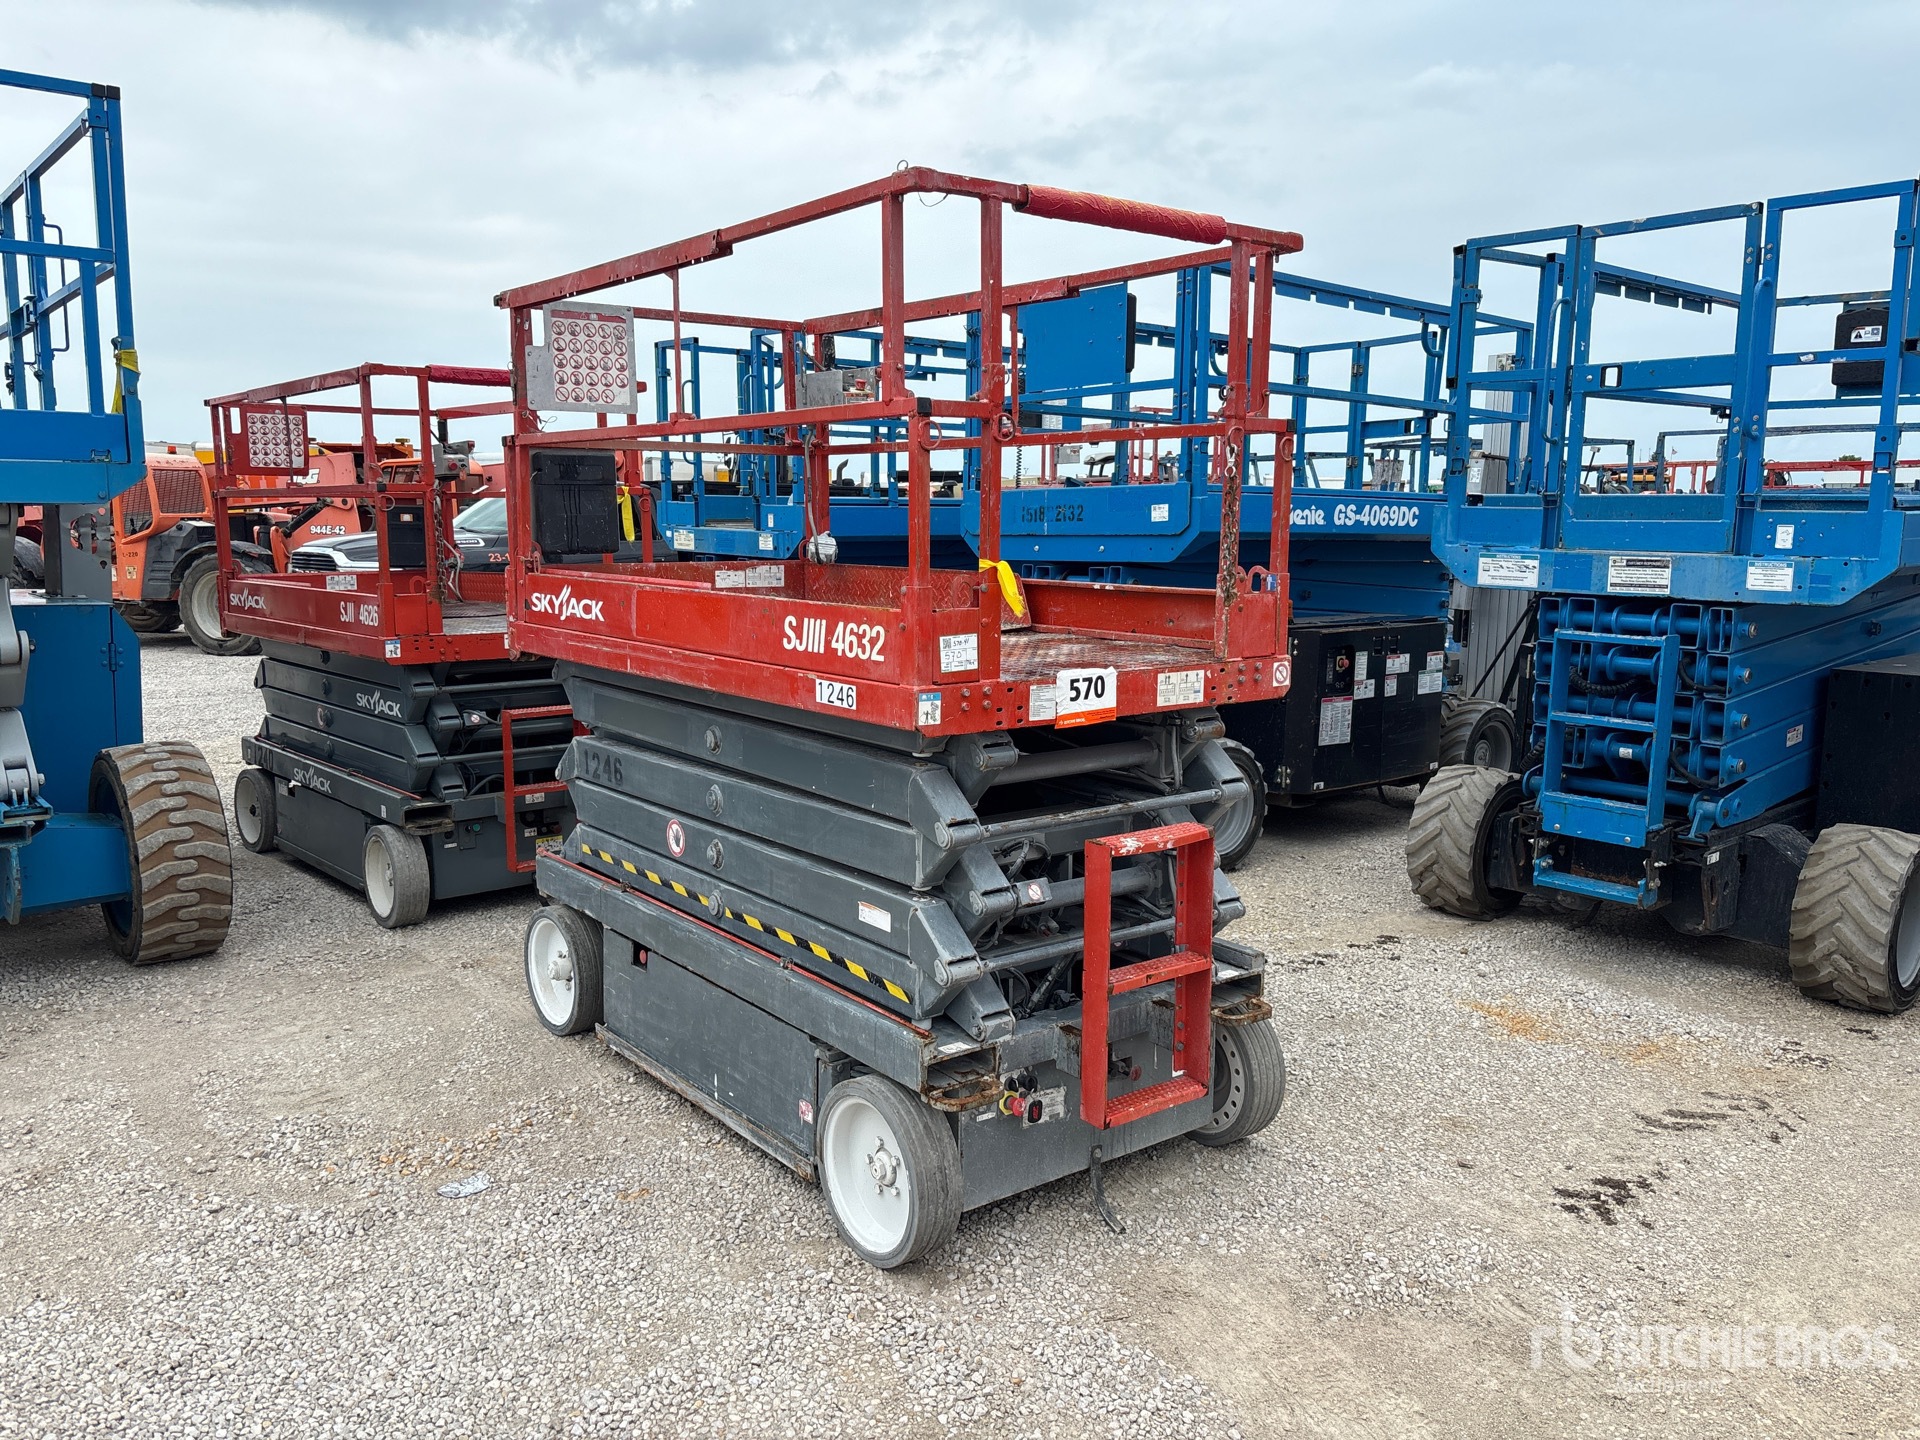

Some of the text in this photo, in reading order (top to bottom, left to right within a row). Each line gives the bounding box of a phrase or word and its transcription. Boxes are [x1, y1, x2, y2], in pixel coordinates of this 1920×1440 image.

[1290, 504, 1419, 527] enie GS-4069DC
[310, 526, 346, 535] 944E-42
[229, 587, 267, 611] SKYJACK
[529, 583, 605, 622] SKYJACK
[359, 604, 379, 627] 4626
[783, 615, 885, 662] SJIII 4632
[818, 681, 855, 708] 1246
[1069, 675, 1106, 702] 570
[356, 690, 402, 718] SKYJACK
[293, 766, 332, 794] SKYJACK
[584, 749, 623, 787] 1246
